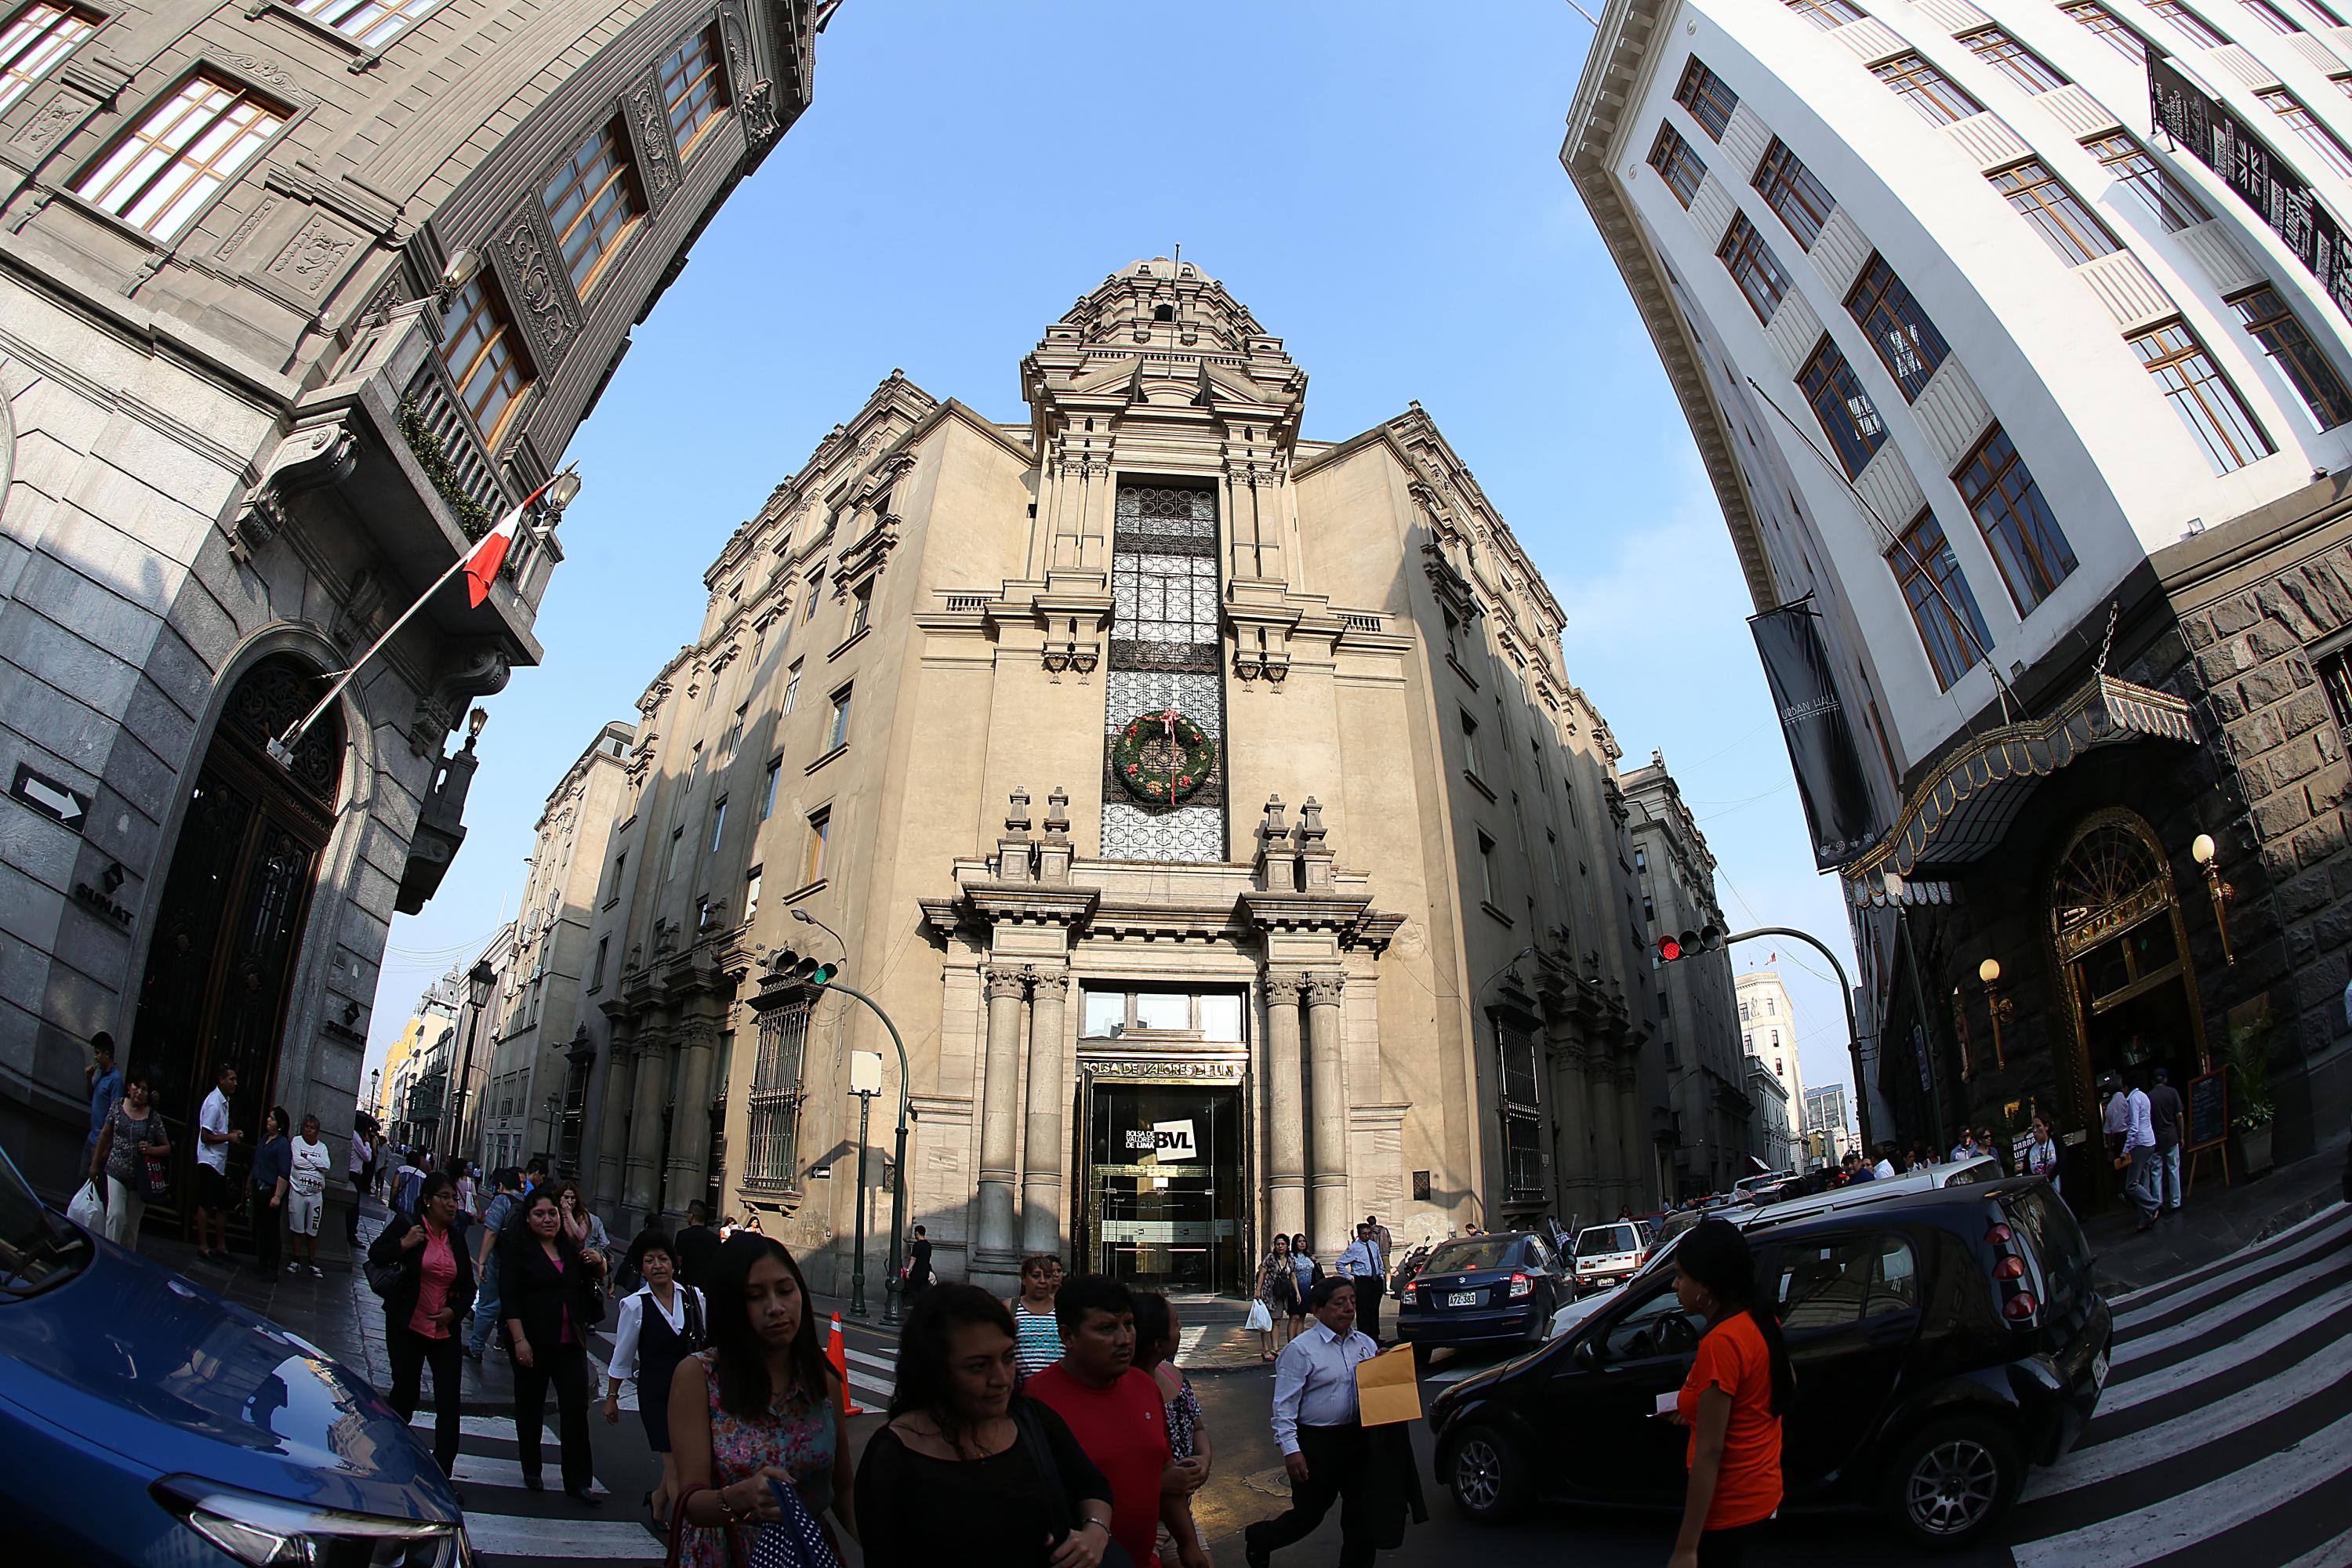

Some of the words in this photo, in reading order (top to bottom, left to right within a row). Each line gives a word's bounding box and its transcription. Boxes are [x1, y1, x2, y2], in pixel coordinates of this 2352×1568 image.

[2164, 103, 2170, 112] EL
[2169, 96, 2177, 132] CENTRO
[2165, 112, 2171, 126] EN
[2285, 198, 2299, 252] LADIES
[1780, 702, 1810, 720] URBAN
[1813, 693, 1838, 708] HALL
[75, 883, 134, 925] SUNAT
[1083, 1062, 1120, 1073] BOLSA
[1122, 1062, 1138, 1074] DE
[1143, 1062, 1192, 1075] VALORES
[1195, 1064, 1213, 1076] DE
[1214, 1064, 1243, 1076] LIMA
[1154, 1131, 1192, 1149] BVL
[2013, 1138, 2036, 1151] BARRA
[312, 1206, 321, 1230] FILA
[1449, 1295, 1475, 1305] A7Z-383
